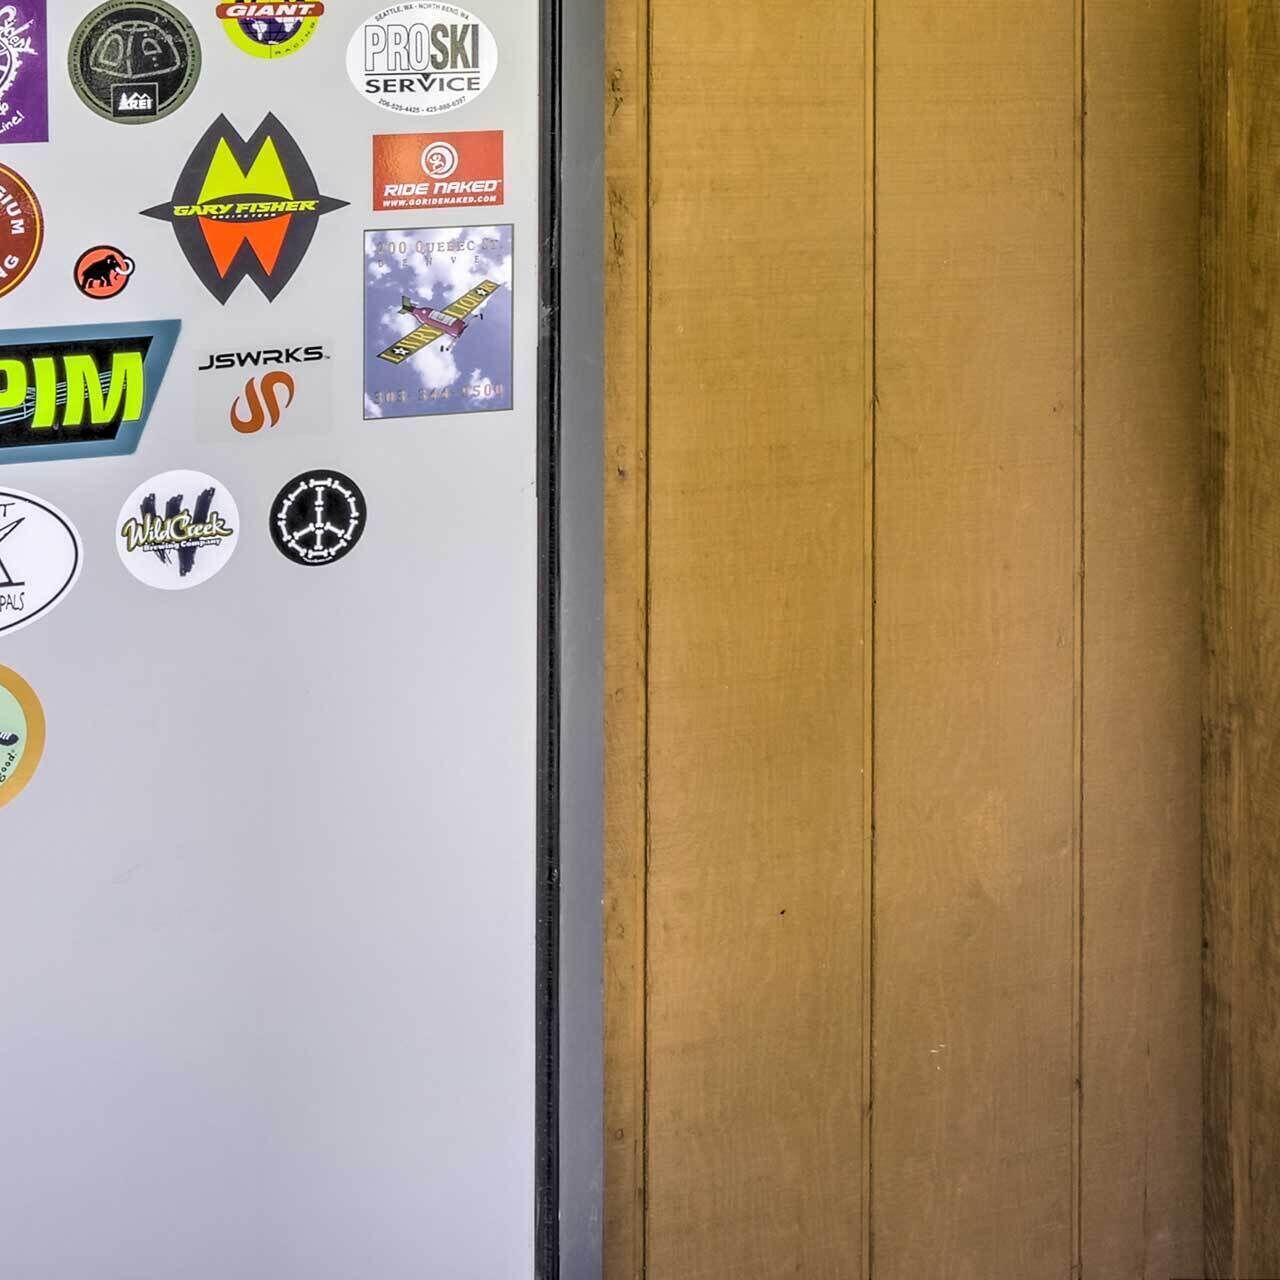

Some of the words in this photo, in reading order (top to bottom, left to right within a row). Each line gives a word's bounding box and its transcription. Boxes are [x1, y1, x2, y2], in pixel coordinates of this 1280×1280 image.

[226, 4, 315, 17] GIANT
[365, 77, 480, 93] SERVICE
[384, 183, 429, 196] RIDE
[433, 180, 497, 195] NAKED
[173, 204, 234, 217] GARY
[236, 200, 318, 213] FISHER
[383, 196, 497, 207] WWW.GORIDENAKED.COM
[416, 240, 475, 254] QUEBEC
[198, 346, 324, 370] JSWRKS
[0, 592, 25, 612] PALS
